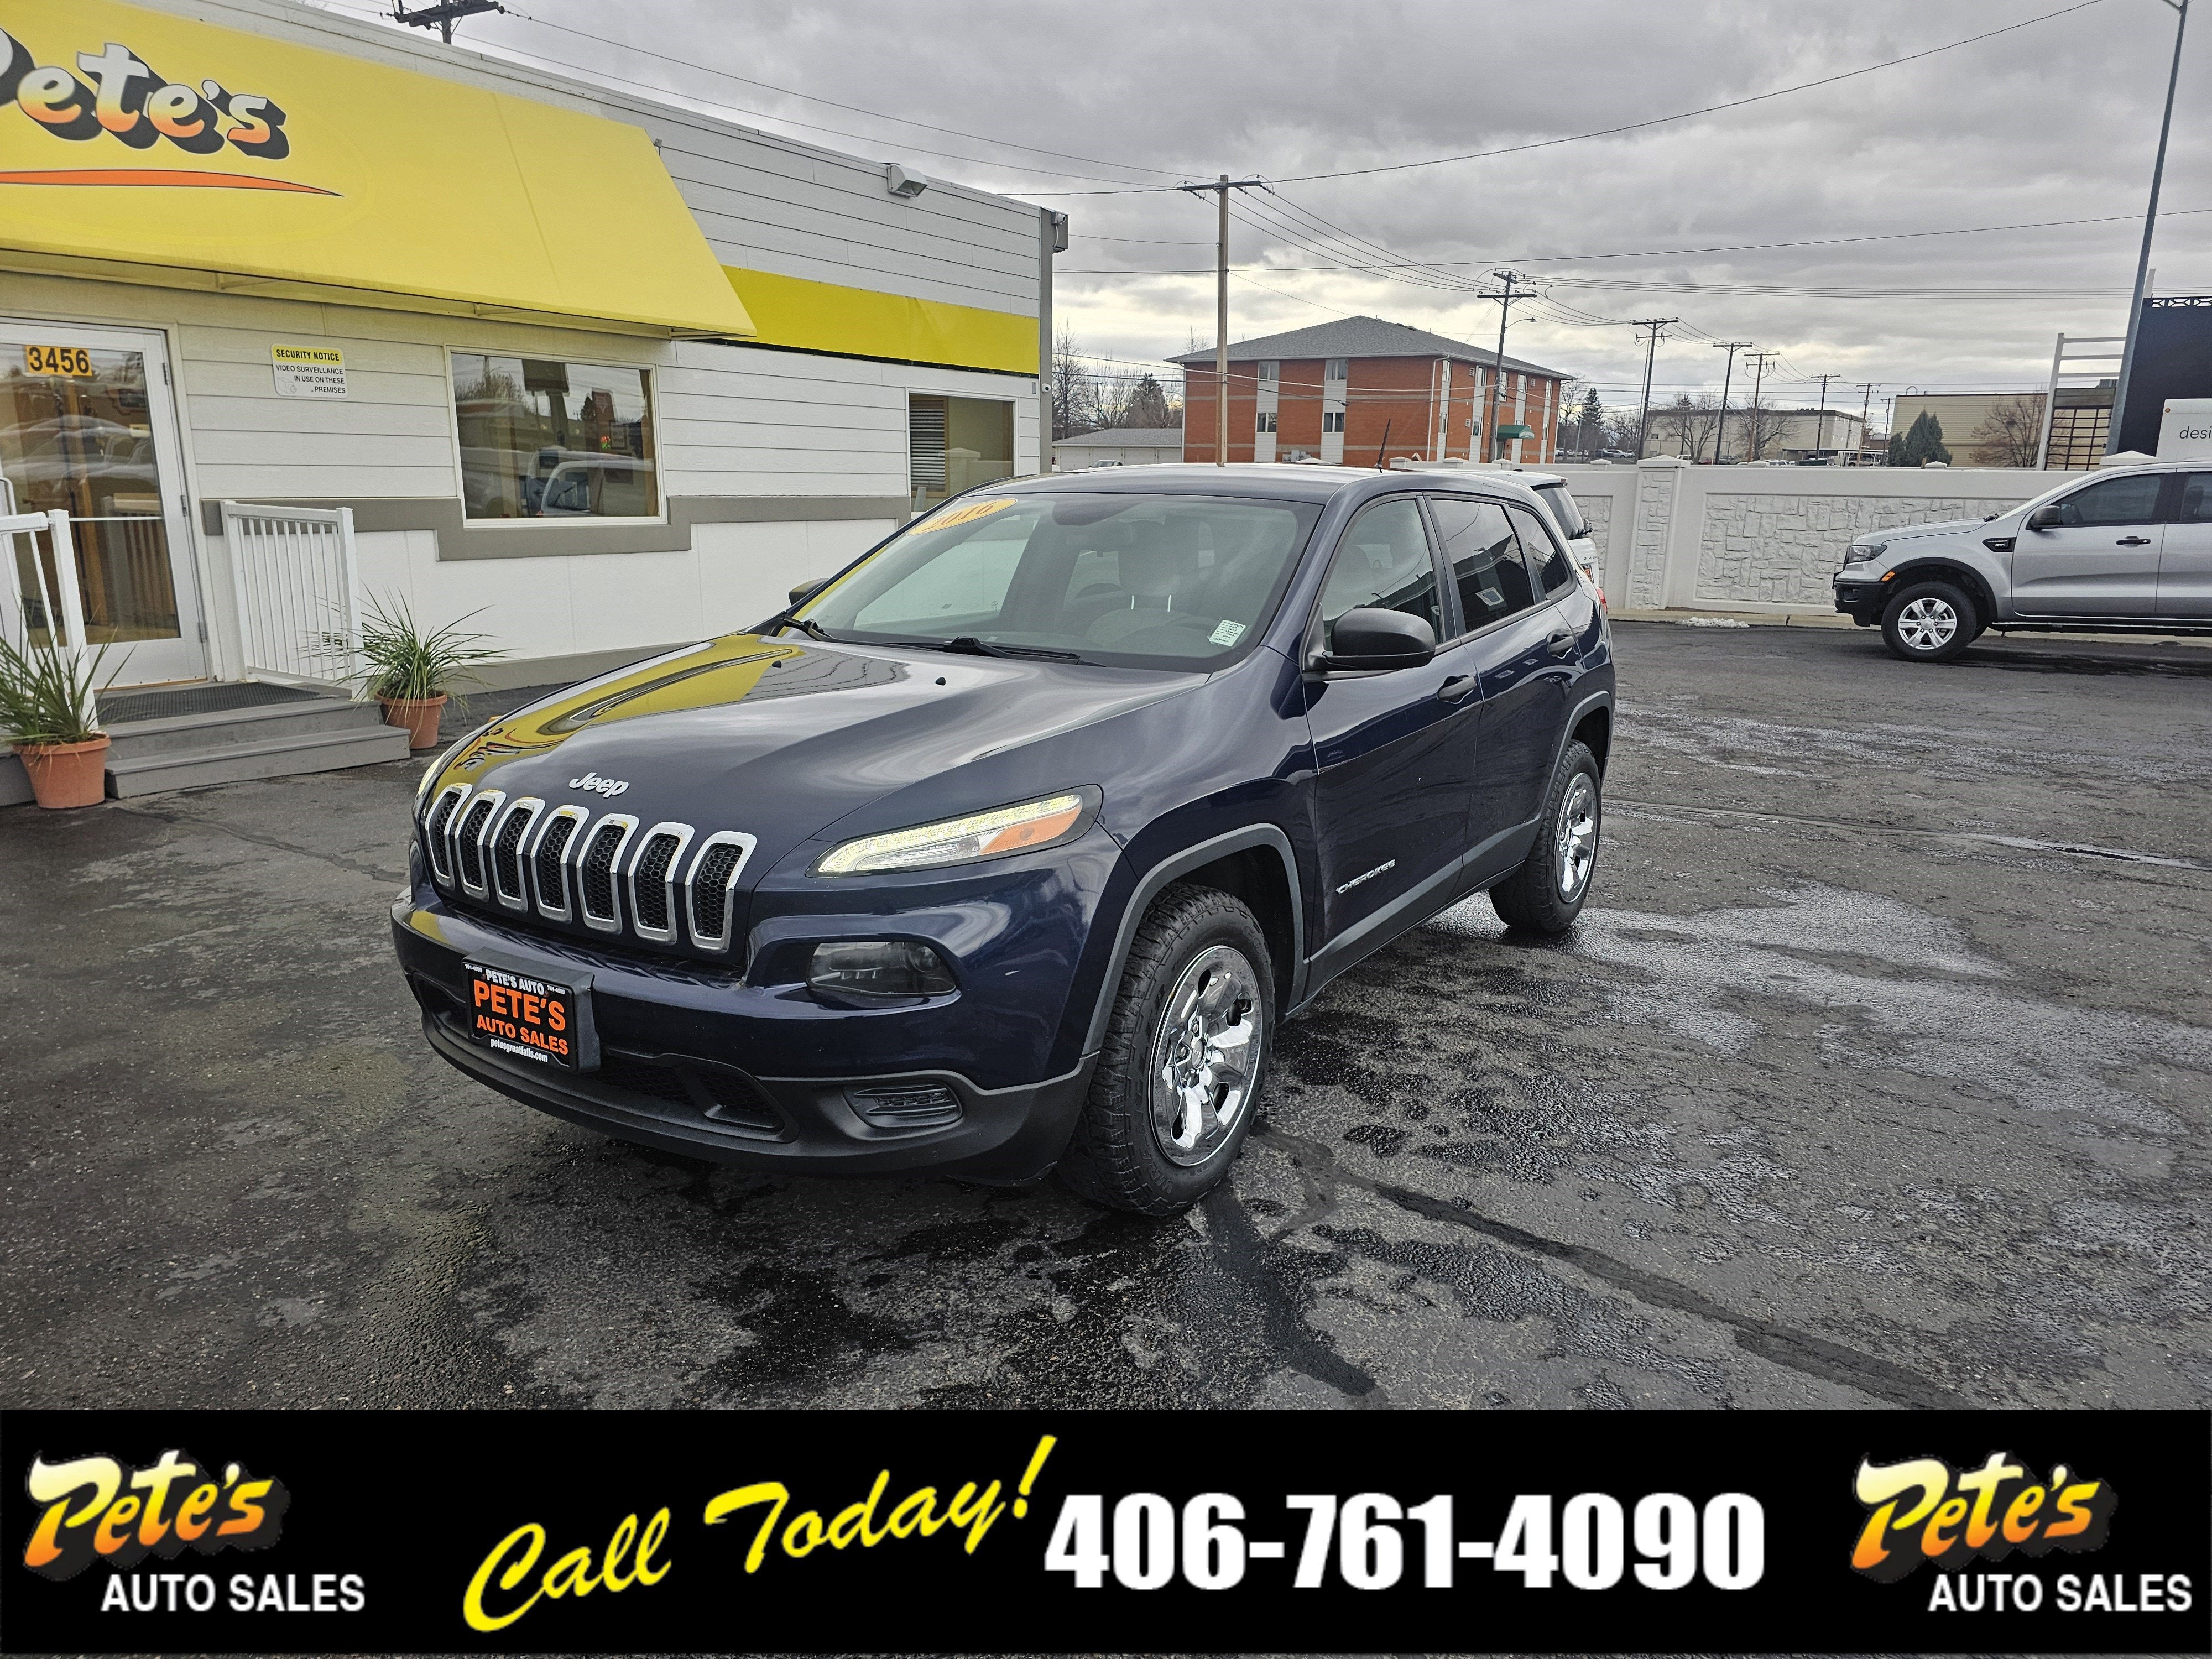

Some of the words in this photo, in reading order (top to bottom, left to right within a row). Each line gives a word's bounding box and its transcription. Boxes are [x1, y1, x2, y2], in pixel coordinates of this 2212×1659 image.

[0, 26, 272, 146] ete's
[29, 347, 90, 374] 3456
[276, 349, 311, 359] SECURITY
[314, 352, 340, 361] NOTICE
[296, 366, 343, 375] SURVEILLANCE
[2179, 425, 2212, 439] desi
[921, 500, 998, 532] 2016
[568, 772, 629, 799] Jeep
[1335, 859, 1396, 895] CHEROKEE
[485, 969, 517, 989] PETE'S
[519, 978, 545, 995] AUTO
[473, 979, 566, 1031] PETE'S
[477, 1015, 516, 1039] AUTO
[520, 1027, 568, 1055] SALES
